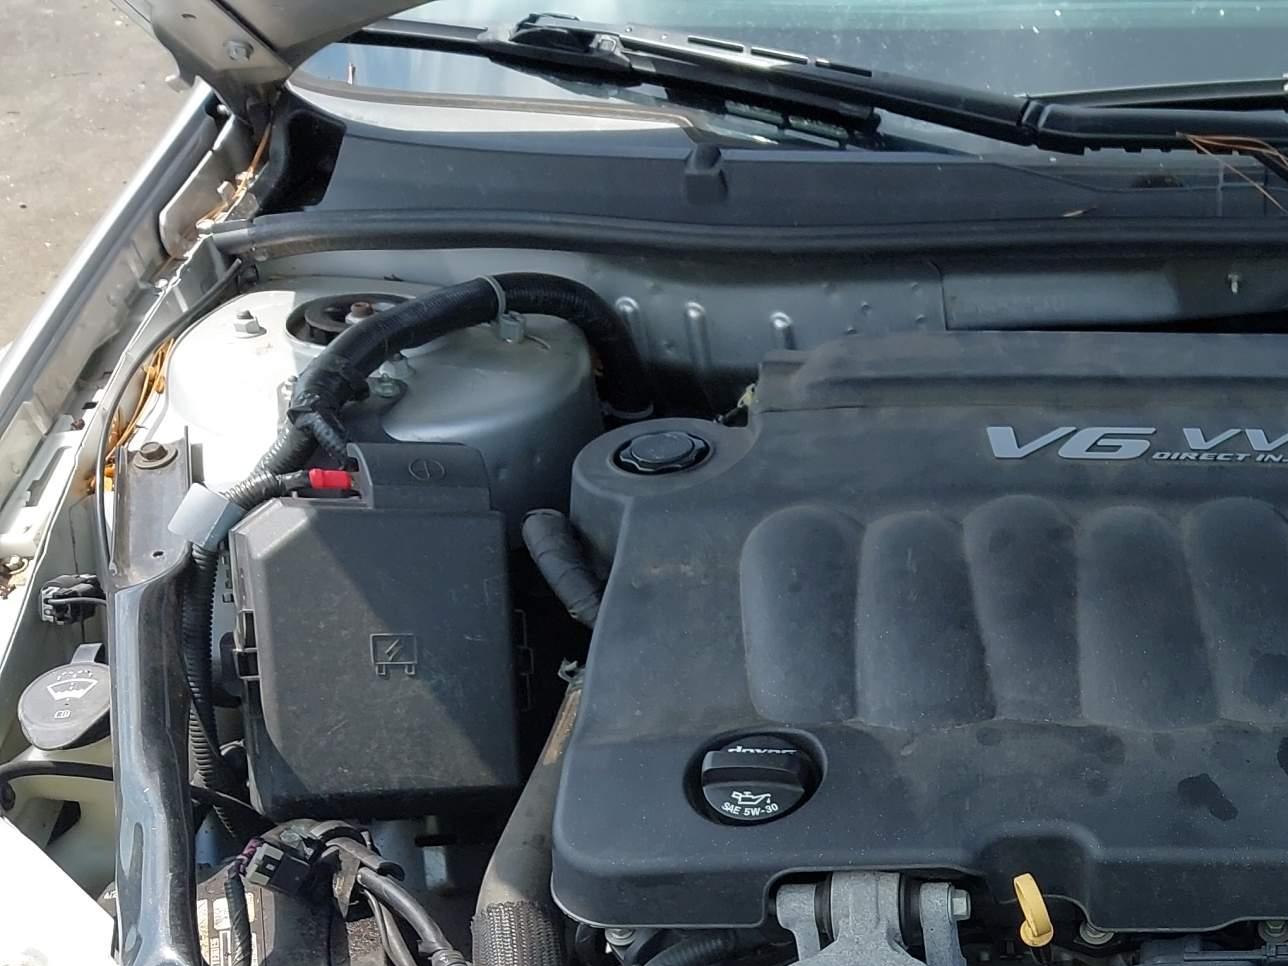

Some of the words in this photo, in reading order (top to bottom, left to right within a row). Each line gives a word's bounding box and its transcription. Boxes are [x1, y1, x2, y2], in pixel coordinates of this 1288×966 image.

[986, 426, 1156, 460] V6
[1152, 451, 1250, 462] DIRECT
[721, 801, 742, 815] SAE
[744, 804, 779, 816] 5W-30
